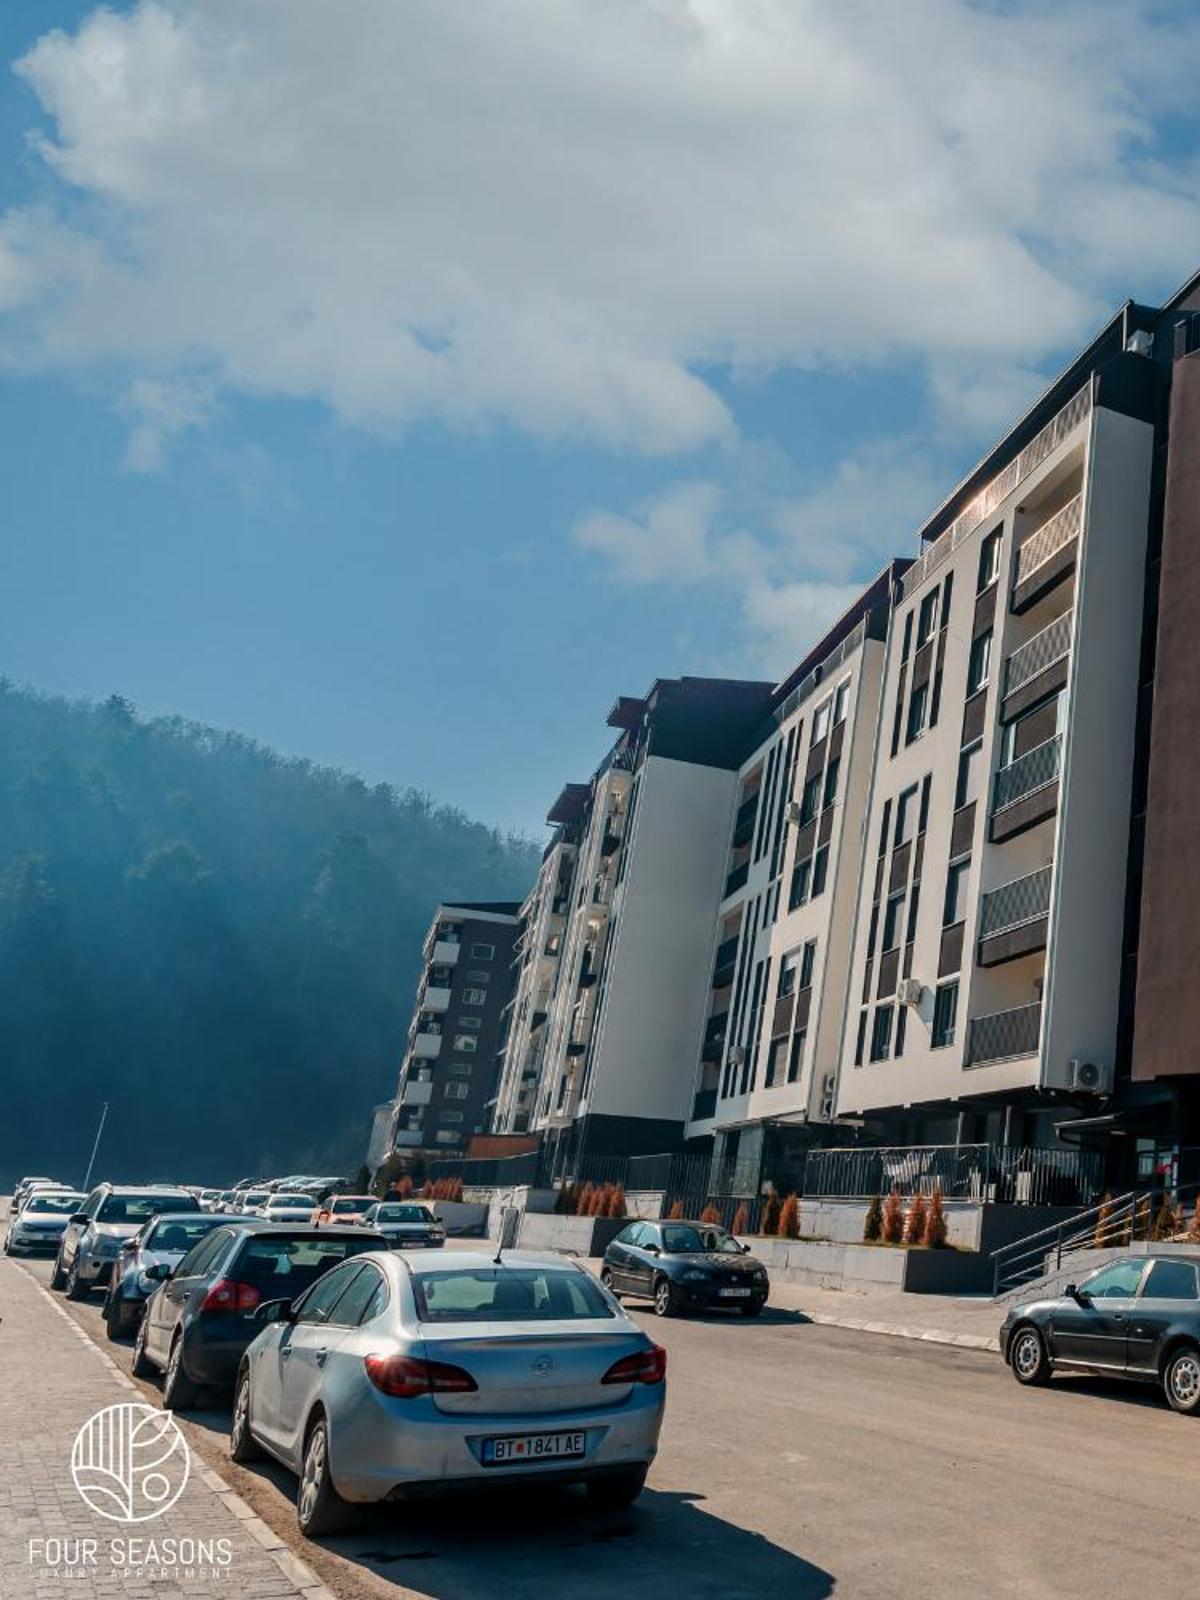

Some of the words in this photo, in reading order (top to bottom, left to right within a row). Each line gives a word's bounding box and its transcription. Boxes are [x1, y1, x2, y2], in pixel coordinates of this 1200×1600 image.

[496, 1441, 514, 1458] BT
[527, 1437, 560, 1455] 1841
[564, 1435, 583, 1451] AE
